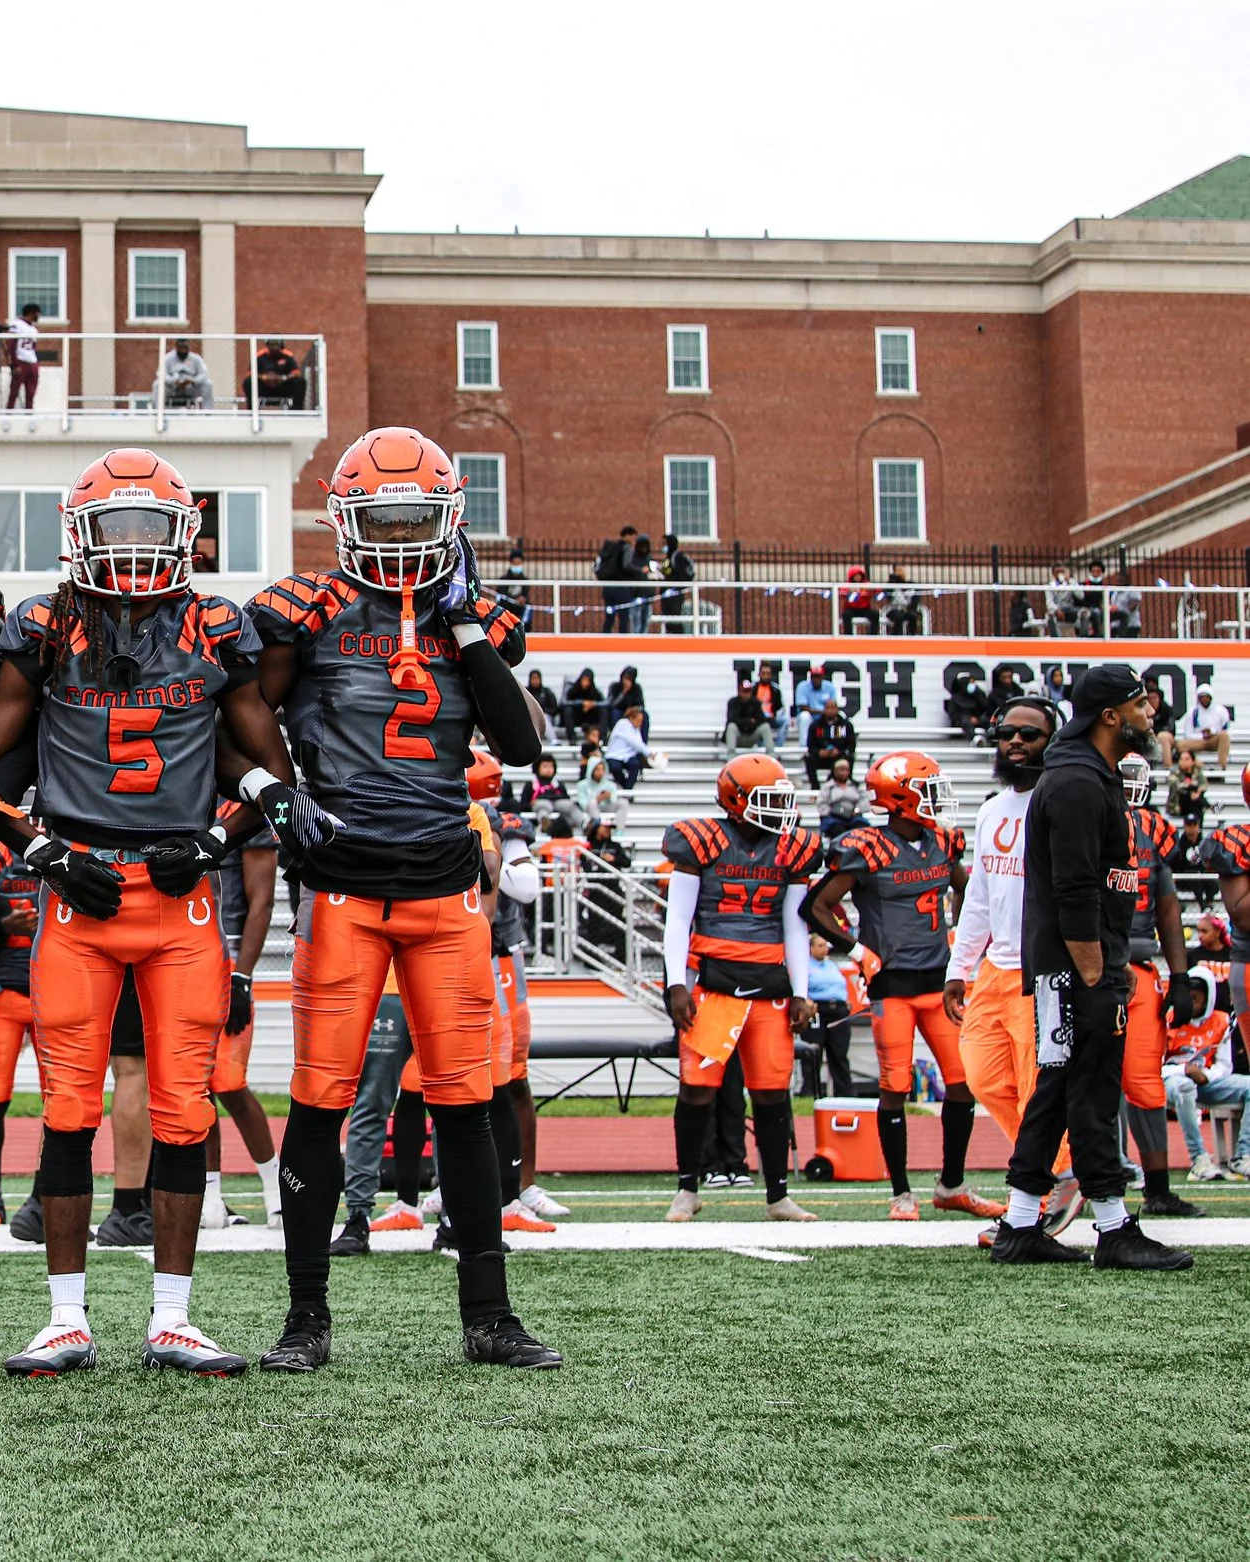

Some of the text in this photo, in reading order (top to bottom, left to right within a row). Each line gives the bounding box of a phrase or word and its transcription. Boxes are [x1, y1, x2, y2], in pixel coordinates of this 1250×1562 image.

[114, 489, 151, 498] Riddell
[381, 485, 417, 494] Riddell
[65, 678, 206, 708] COOLIDGE
[382, 667, 442, 761] 2
[106, 706, 167, 794] 5
[715, 862, 784, 881] COOLIDGE
[892, 863, 950, 885] COOLIDGE
[914, 885, 941, 933] 4
[281, 1166, 306, 1193] SAXX
